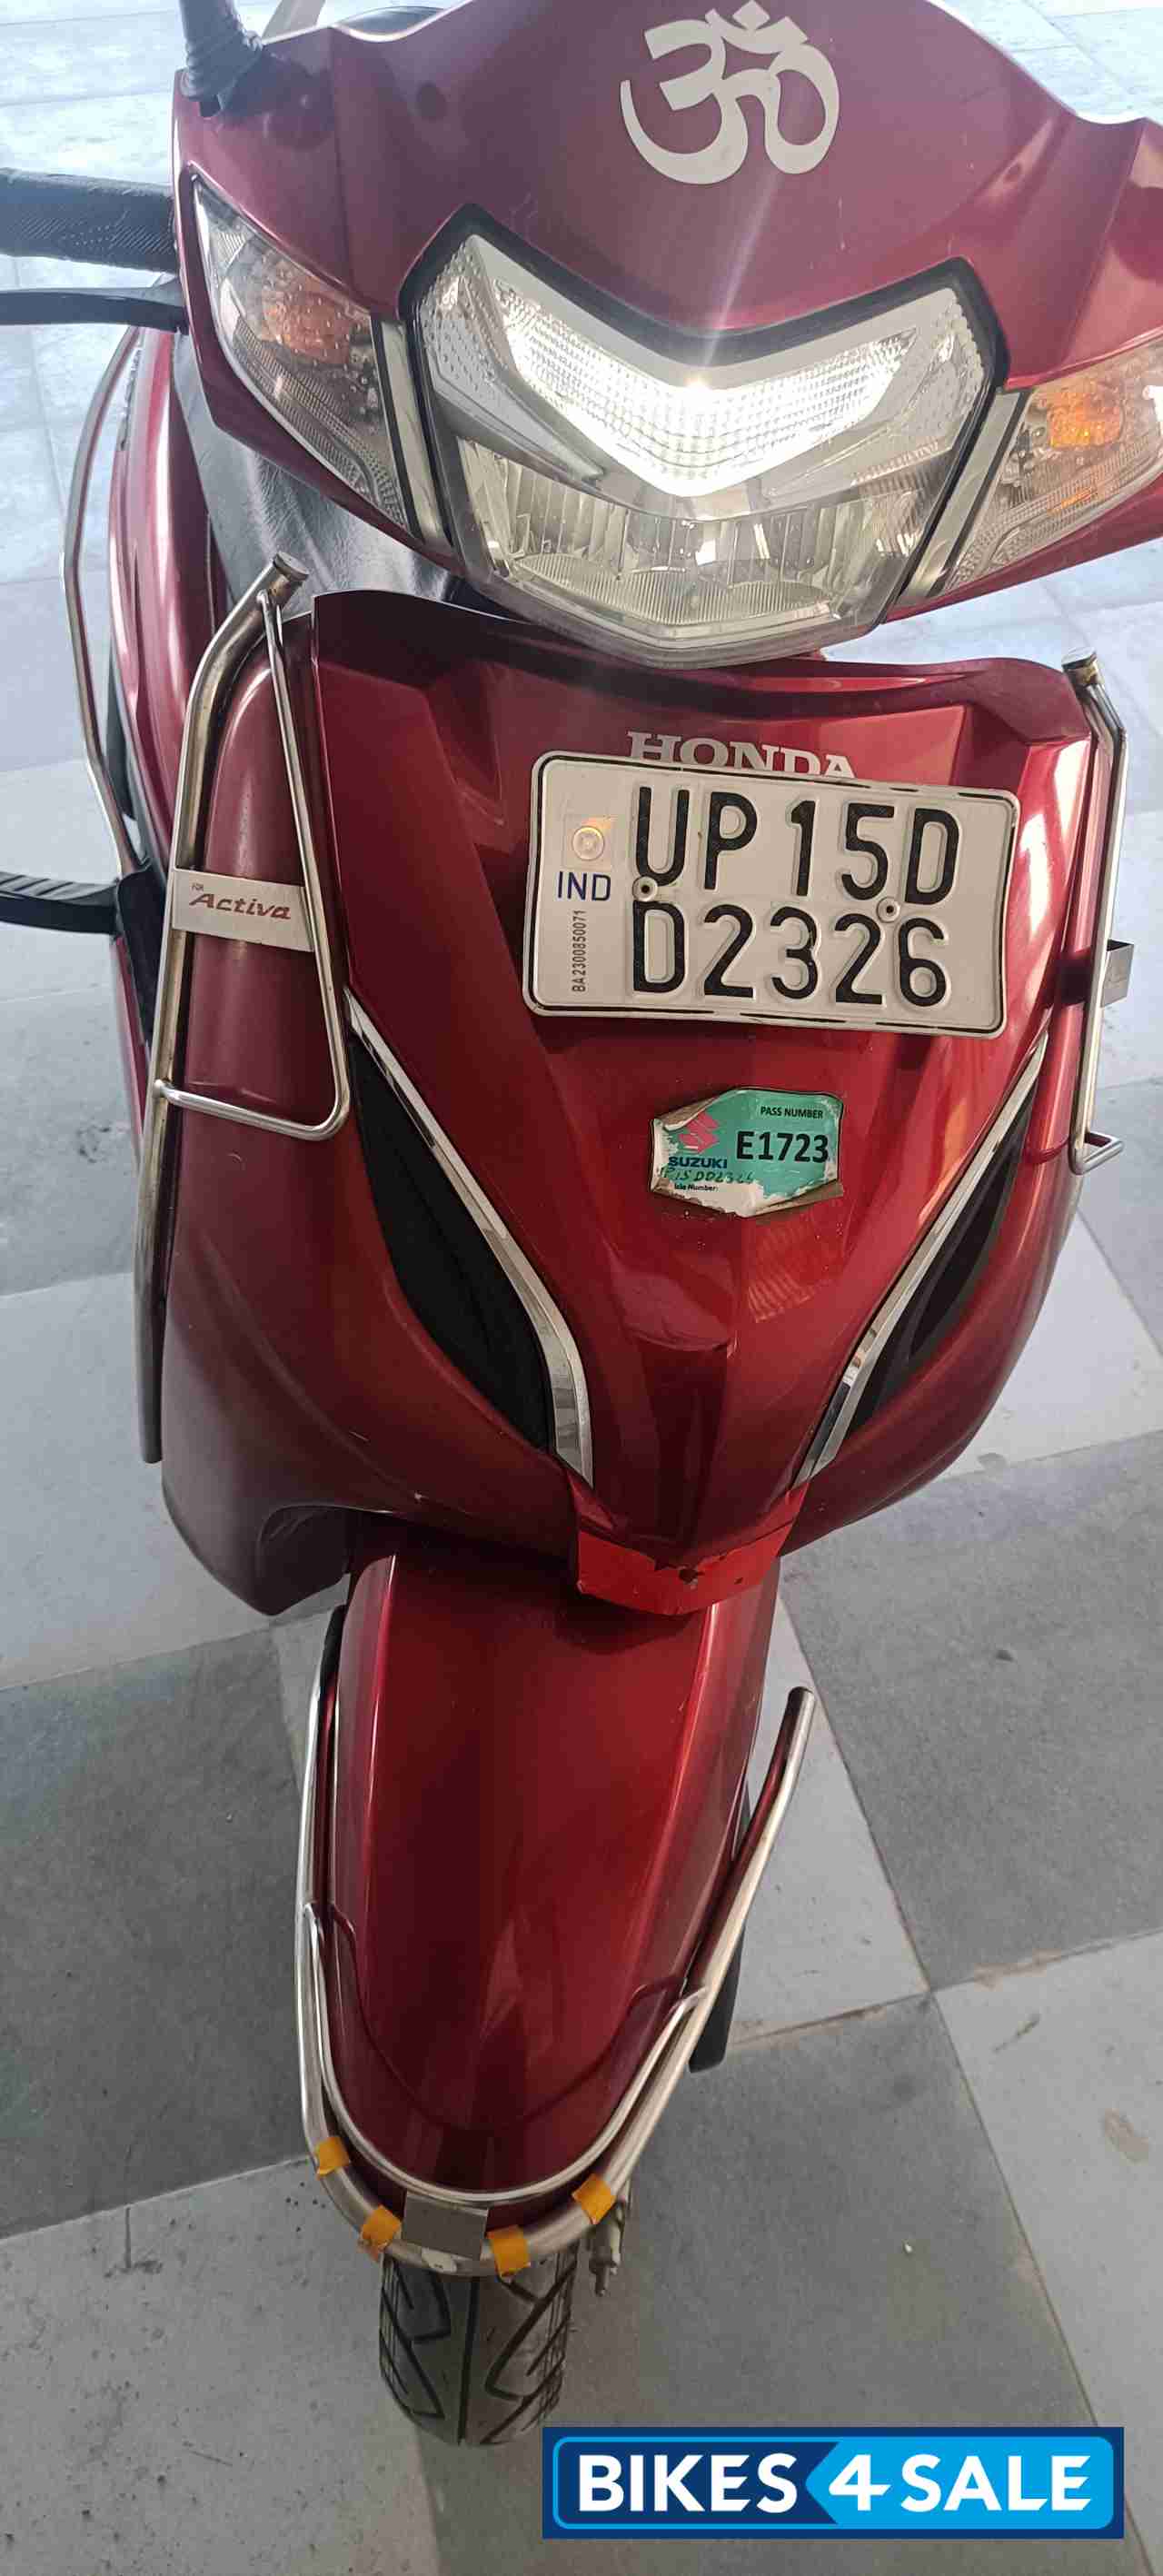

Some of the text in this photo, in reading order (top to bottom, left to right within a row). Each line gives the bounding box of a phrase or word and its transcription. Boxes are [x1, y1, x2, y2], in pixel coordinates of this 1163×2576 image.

[628, 731, 856, 779] HONDA
[557, 870, 611, 901] IND
[189, 893, 292, 920] Activa
[632, 900, 947, 1007] D2326
[760, 1106, 823, 1119] PASS NUMBER
[736, 1131, 829, 1163] E1723
[669, 1157, 727, 1169] SUZUKI
